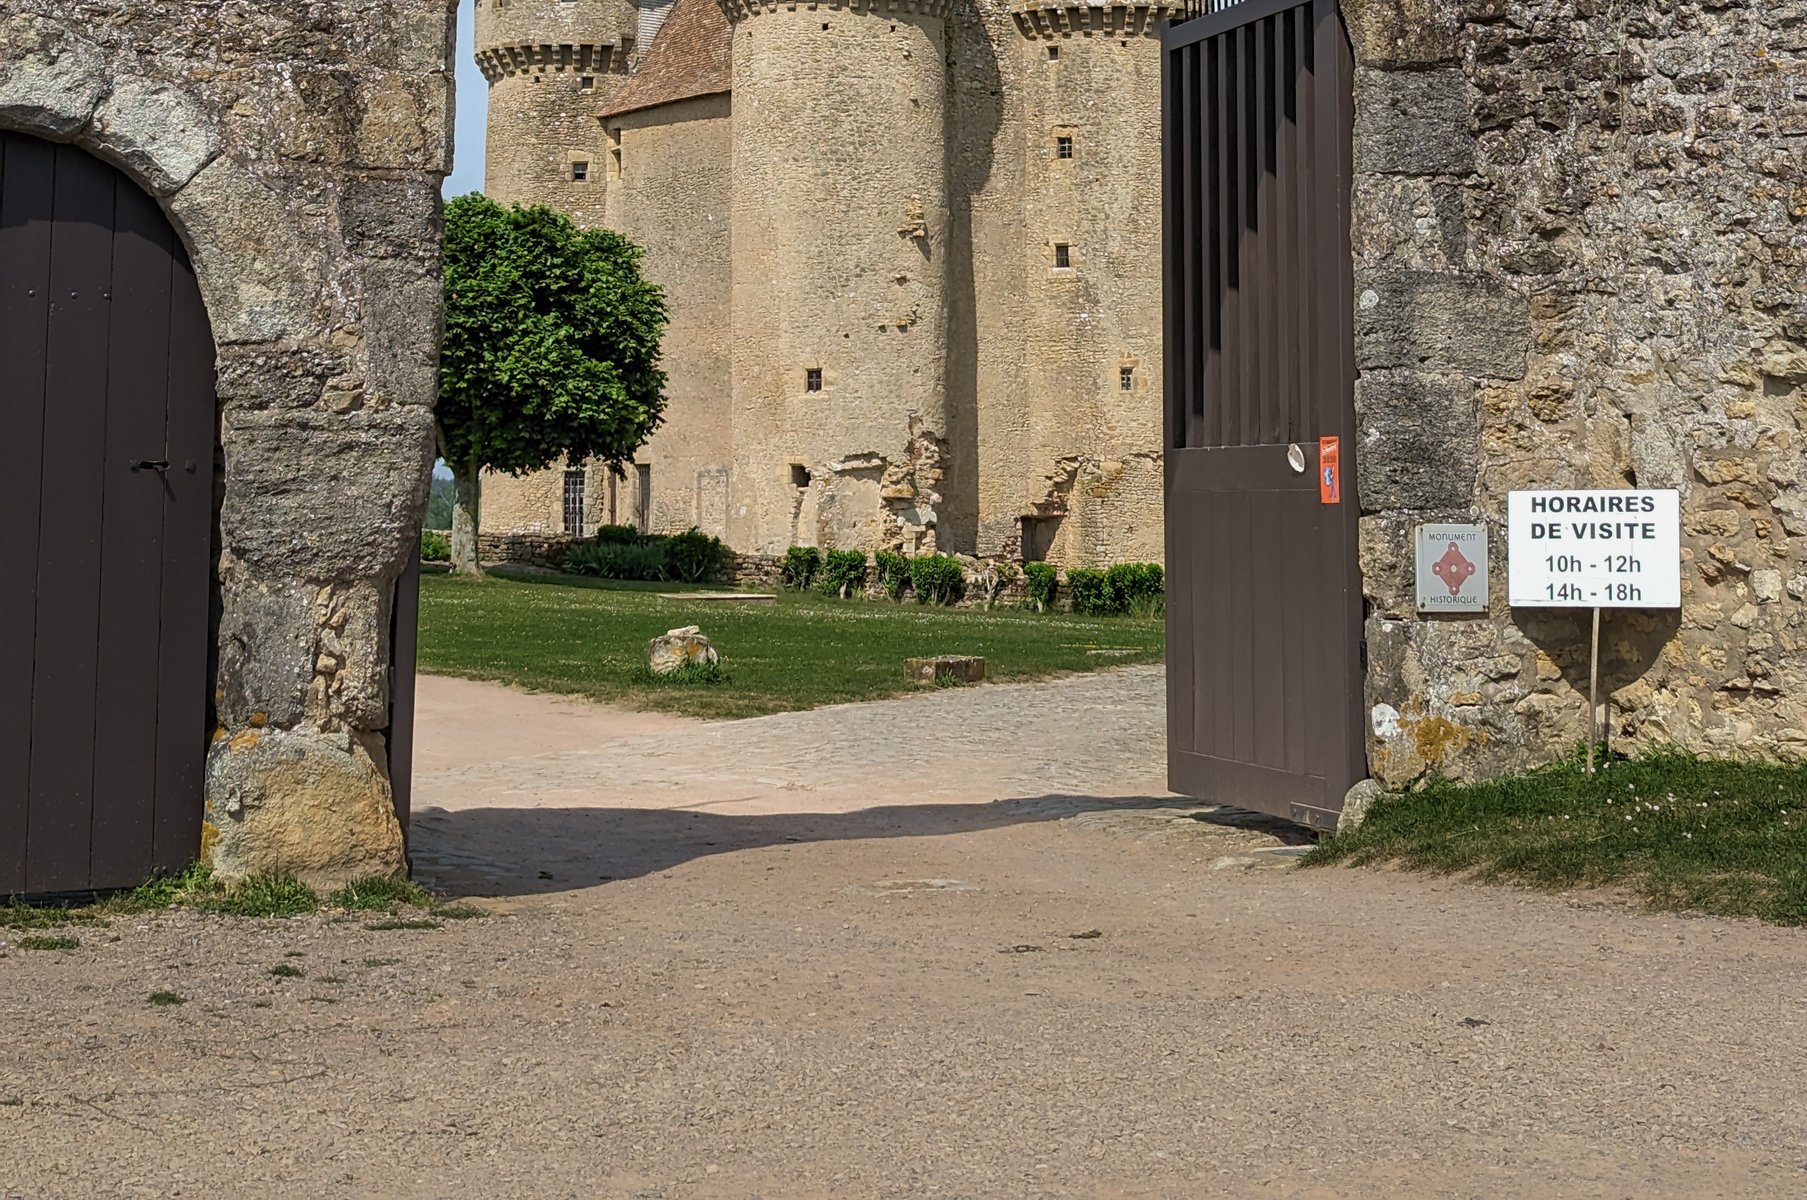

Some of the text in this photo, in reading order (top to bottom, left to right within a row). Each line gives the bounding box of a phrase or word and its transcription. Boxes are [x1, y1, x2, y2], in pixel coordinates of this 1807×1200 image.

[1531, 496, 1655, 513] HORAIRES
[1428, 533, 1476, 541] MONUMENT
[1531, 523, 1656, 540] DE VISITE
[1546, 555, 1582, 573] 10h
[1604, 555, 1641, 573] 12h
[1430, 596, 1477, 604] HISTORIQUE
[1546, 583, 1582, 601] 14h
[1604, 583, 1642, 601] 18h
